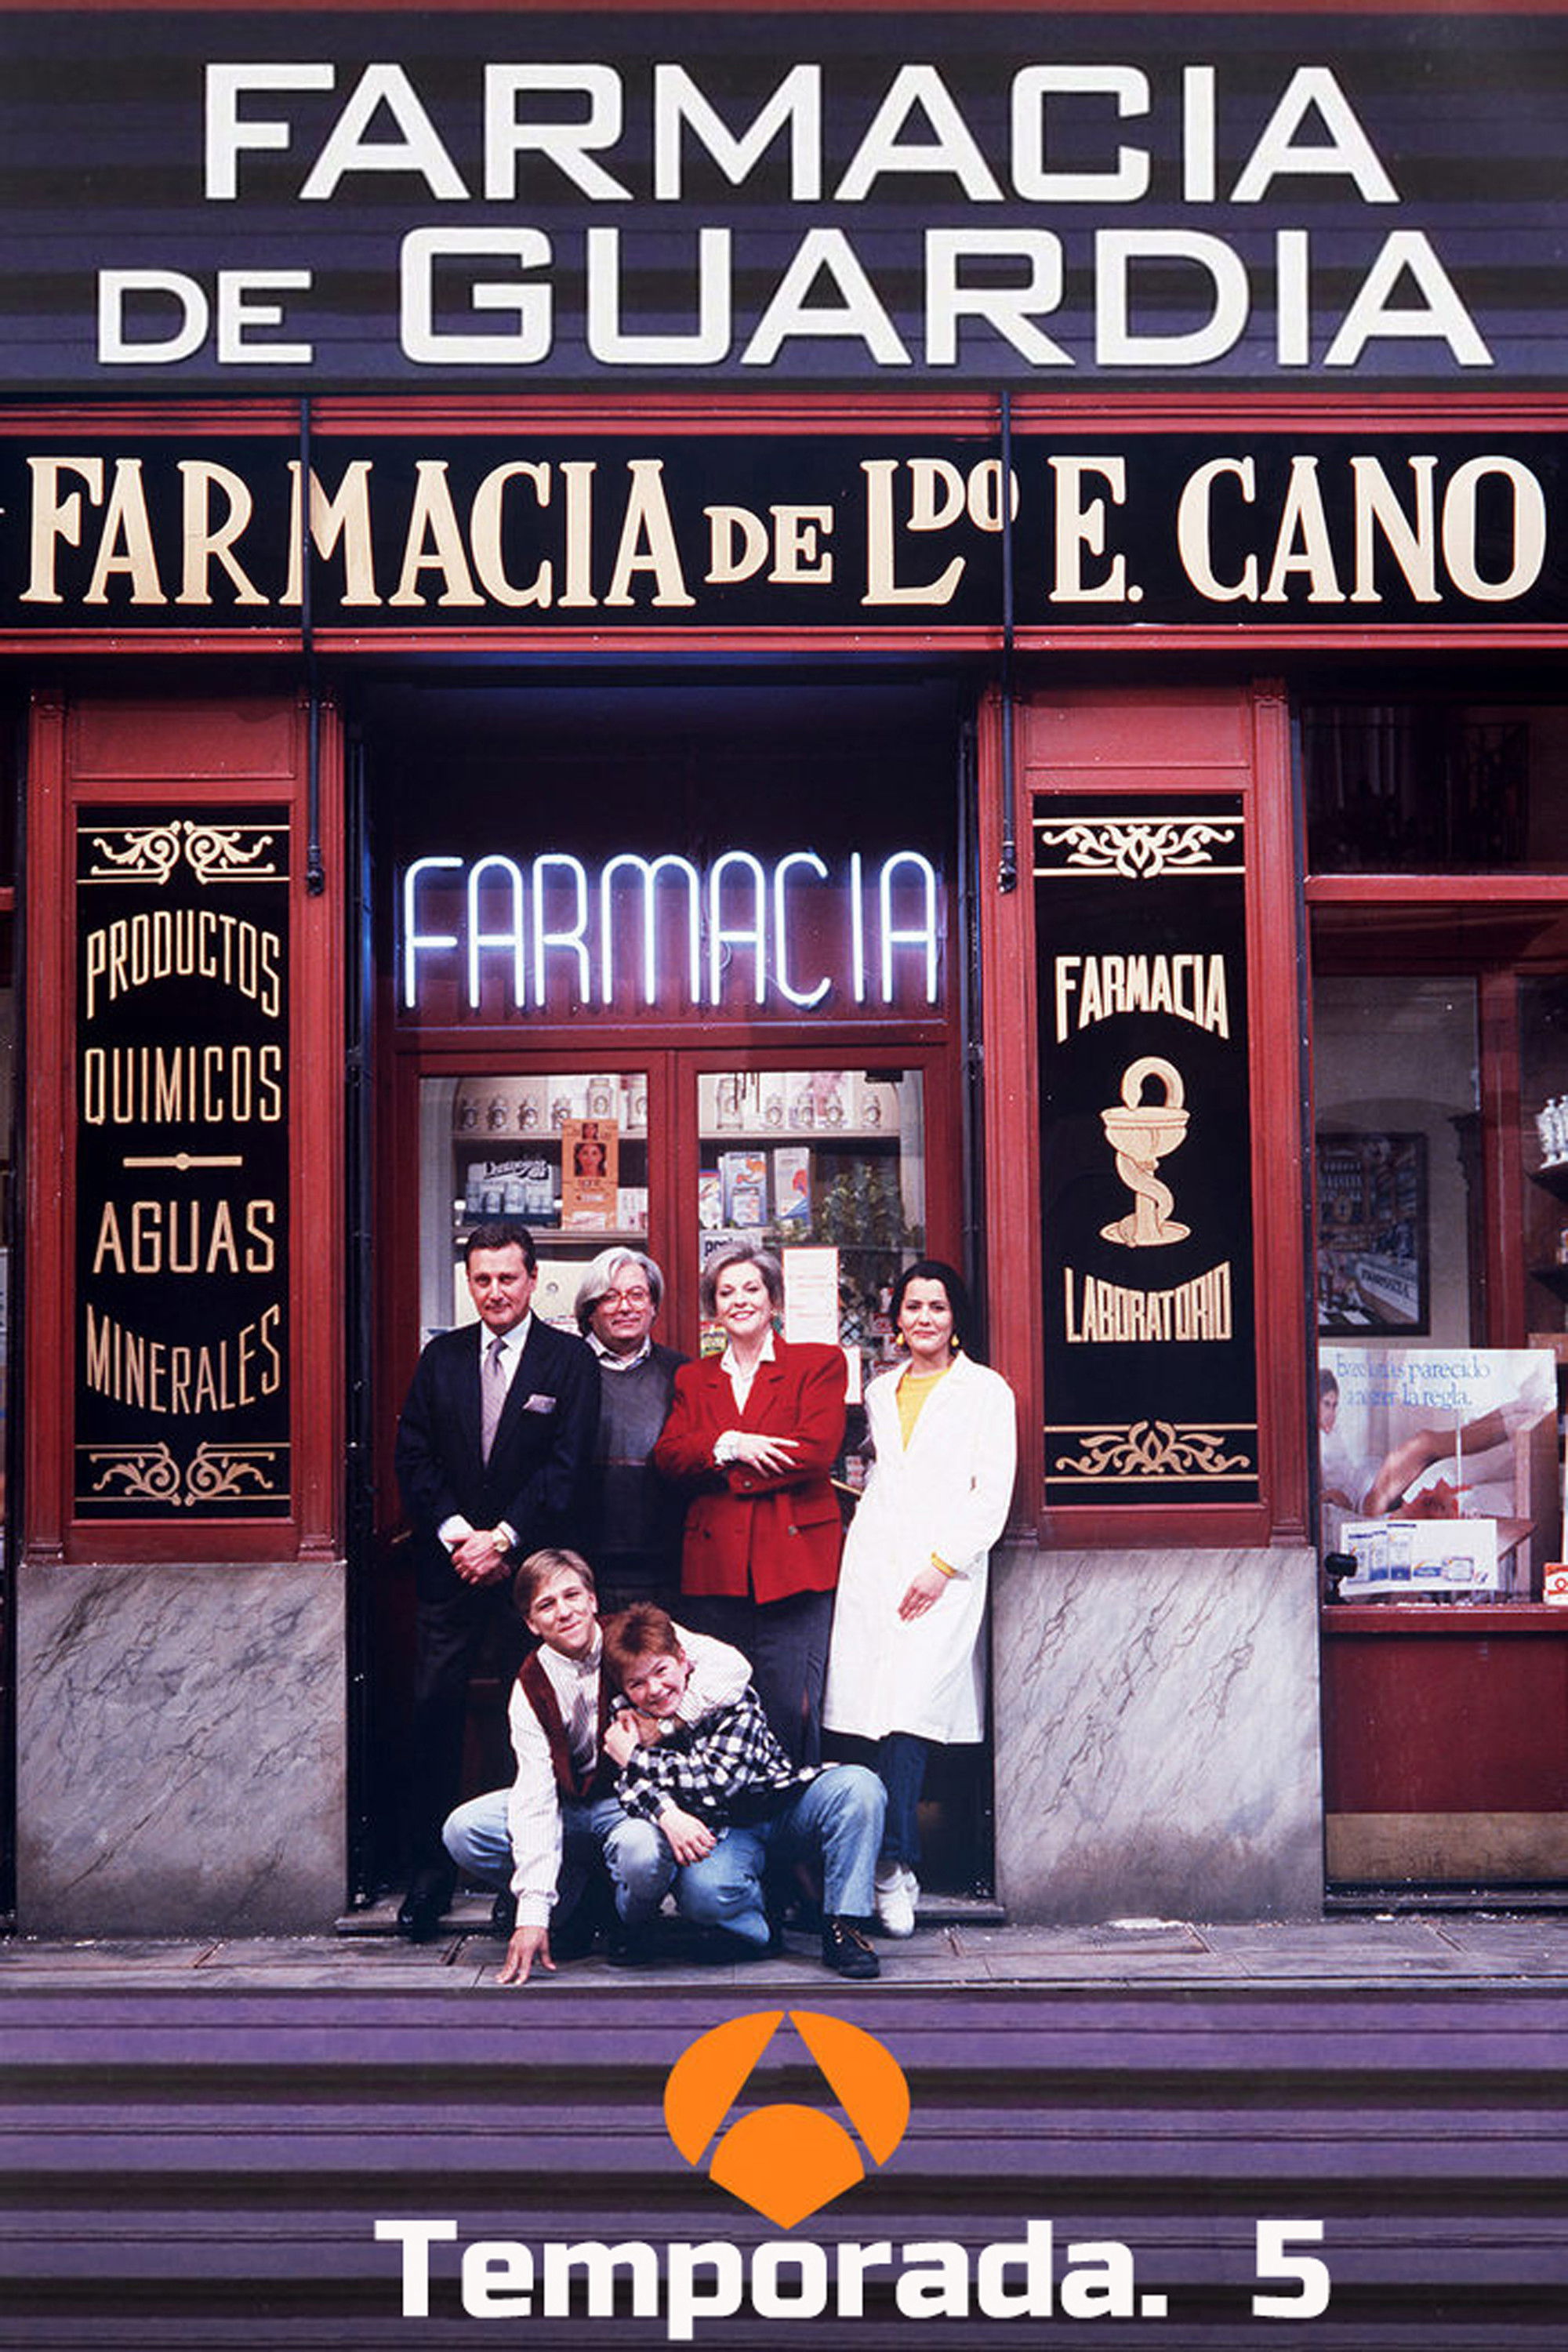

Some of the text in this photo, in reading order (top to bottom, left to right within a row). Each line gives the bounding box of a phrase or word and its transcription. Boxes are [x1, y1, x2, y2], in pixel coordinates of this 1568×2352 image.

[19, 456, 696, 608] FARMACIA
[703, 504, 834, 583] DE
[1047, 456, 1144, 602] E.
[1177, 455, 1547, 602] CANO
[86, 909, 280, 1020] PRODUCTOS
[404, 850, 936, 1008] FARMACIA
[1054, 954, 1230, 1044] FARMACIA
[84, 1045, 281, 1125] QUIMICOS
[93, 1199, 275, 1274] AGUAS
[1064, 1261, 1232, 1343] LABORATORIO
[86, 1302, 281, 1414] MINERALES
